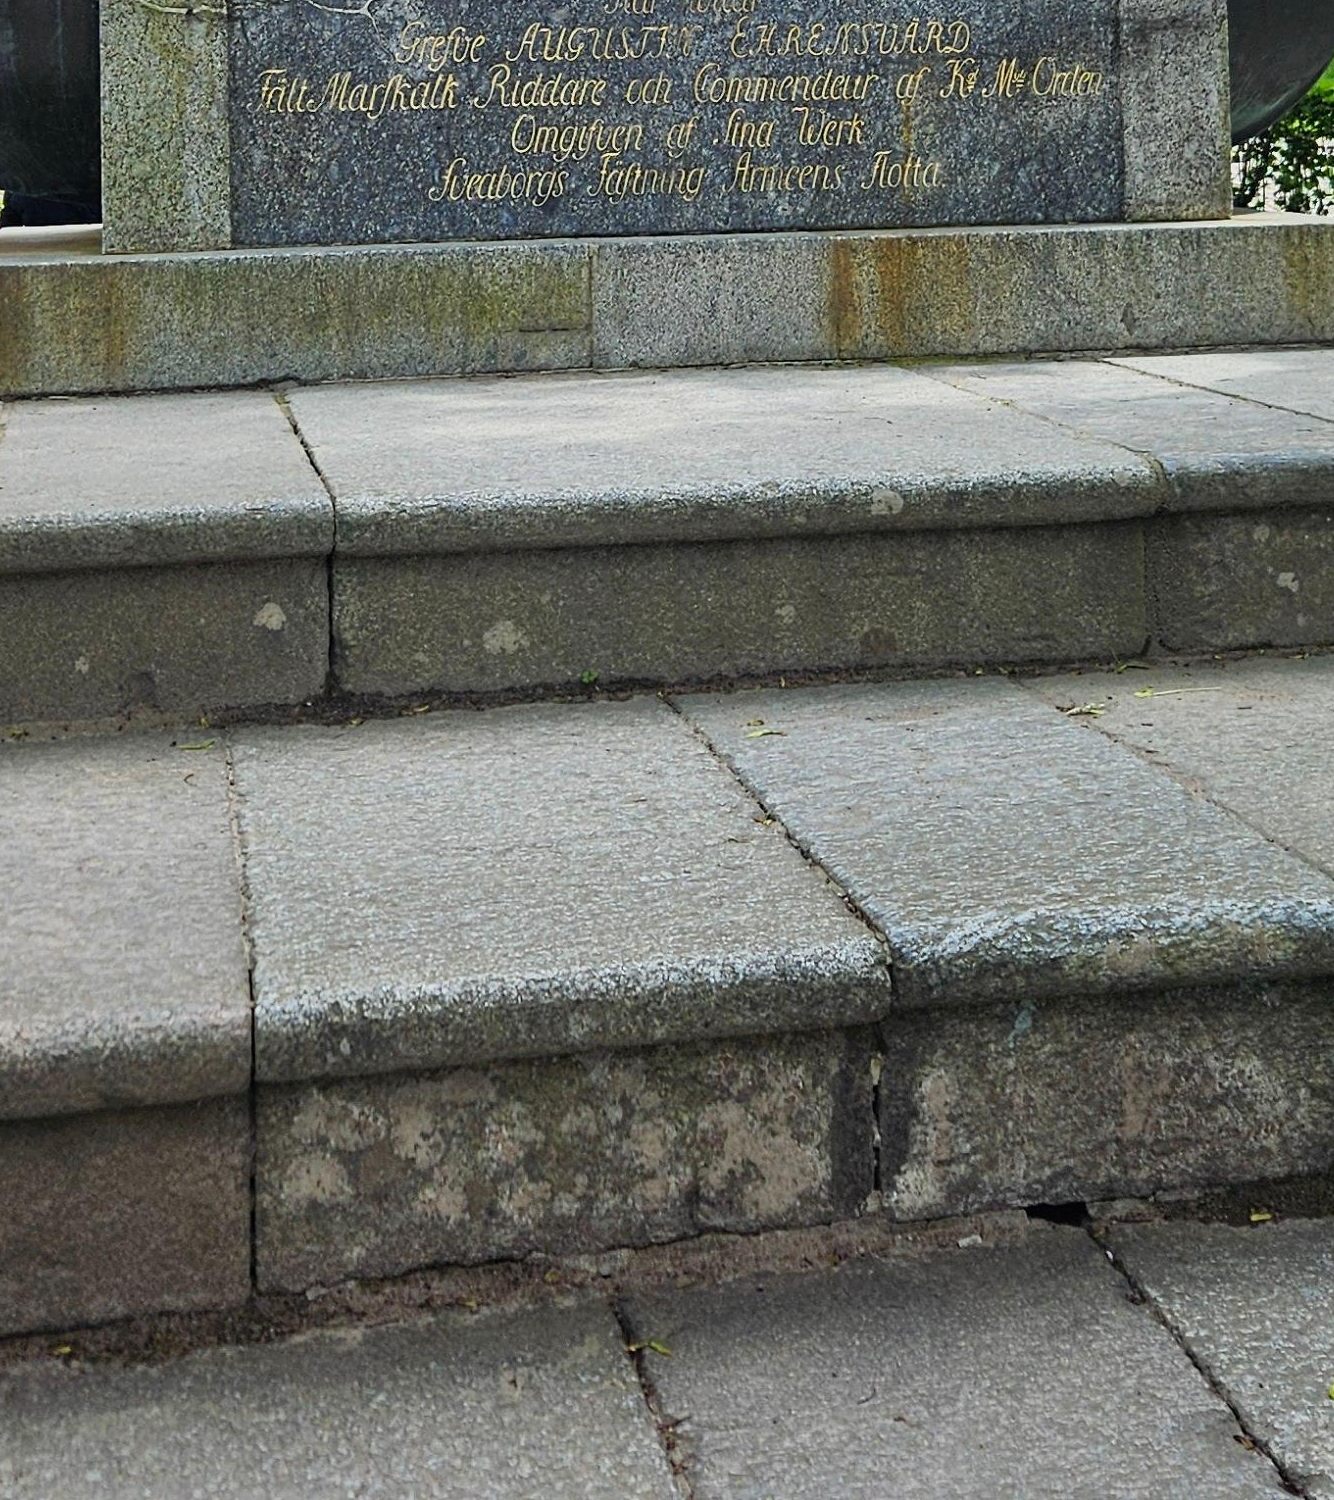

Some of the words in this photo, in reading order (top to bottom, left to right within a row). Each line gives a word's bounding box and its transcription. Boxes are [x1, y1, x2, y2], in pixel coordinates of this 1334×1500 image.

[395, 21, 486, 72] Grefve
[625, 71, 673, 105] och
[694, 62, 880, 103] Commendeur
[896, 66, 931, 106] af
[1032, 56, 1104, 97] Orden
[666, 116, 699, 158] af
